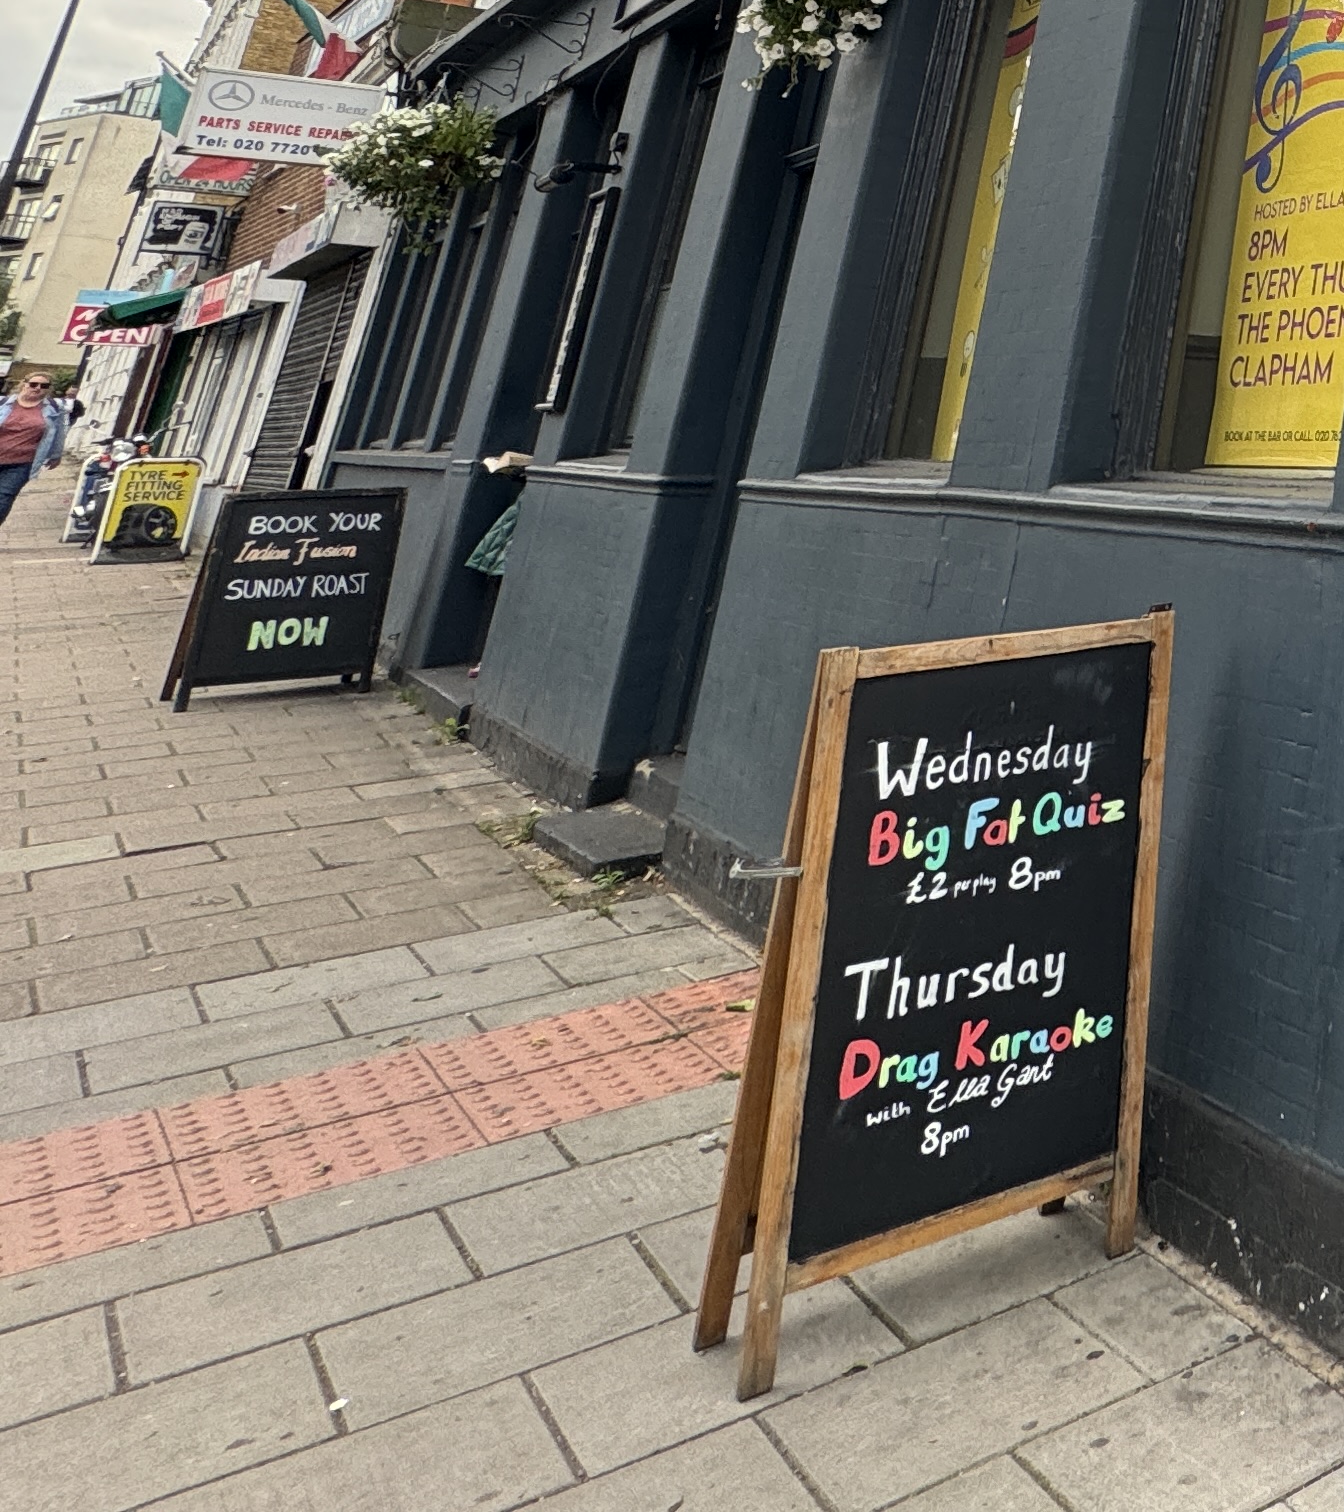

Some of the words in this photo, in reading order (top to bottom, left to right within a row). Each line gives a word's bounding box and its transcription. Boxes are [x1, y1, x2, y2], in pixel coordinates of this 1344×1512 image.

[260, 93, 324, 112] Mercedes
[336, 102, 369, 116] Benz
[198, 115, 242, 130] PARTS
[247, 120, 303, 137] SERVICE
[196, 134, 227, 148] Tel:
[233, 138, 264, 152] 020
[270, 142, 311, 156] 7720
[1253, 196, 1296, 222] HOSTED
[1299, 194, 1314, 214] BY
[1247, 225, 1289, 262] 8PM
[1241, 264, 1305, 303] EVERY
[1236, 310, 1273, 345] THE
[1229, 349, 1335, 388] CLAPHAM
[1224, 430, 1242, 442] BOOK
[1243, 430, 1254, 442] AT
[1254, 430, 1267, 442] THE
[1282, 430, 1293, 442] OR
[125, 479, 184, 492] FITTING
[130, 470, 168, 481] TYRE
[122, 490, 185, 503] SERVICE
[248, 515, 319, 535] BOOK
[328, 512, 383, 532] YOUR
[233, 540, 291, 563] Indian
[293, 537, 358, 566] Fusion
[224, 575, 307, 601] SUNDAY
[310, 572, 370, 598] ROAST
[246, 616, 330, 651] NOW
[875, 724, 1092, 801] Wednesday
[867, 809, 950, 871] Big
[963, 796, 1027, 850] Fat
[1032, 790, 1127, 836] Quiz
[905, 871, 948, 904] £2
[953, 880, 972, 898] per
[972, 874, 997, 895] play
[1007, 856, 1062, 893] 8pm
[844, 944, 1066, 1022] Thursday
[838, 1039, 940, 1100] Drag
[954, 1007, 1114, 1072] Karaoke
[866, 1101, 911, 1128] with
[926, 1073, 989, 1115] Ella
[920, 1121, 970, 1158] 8pm
